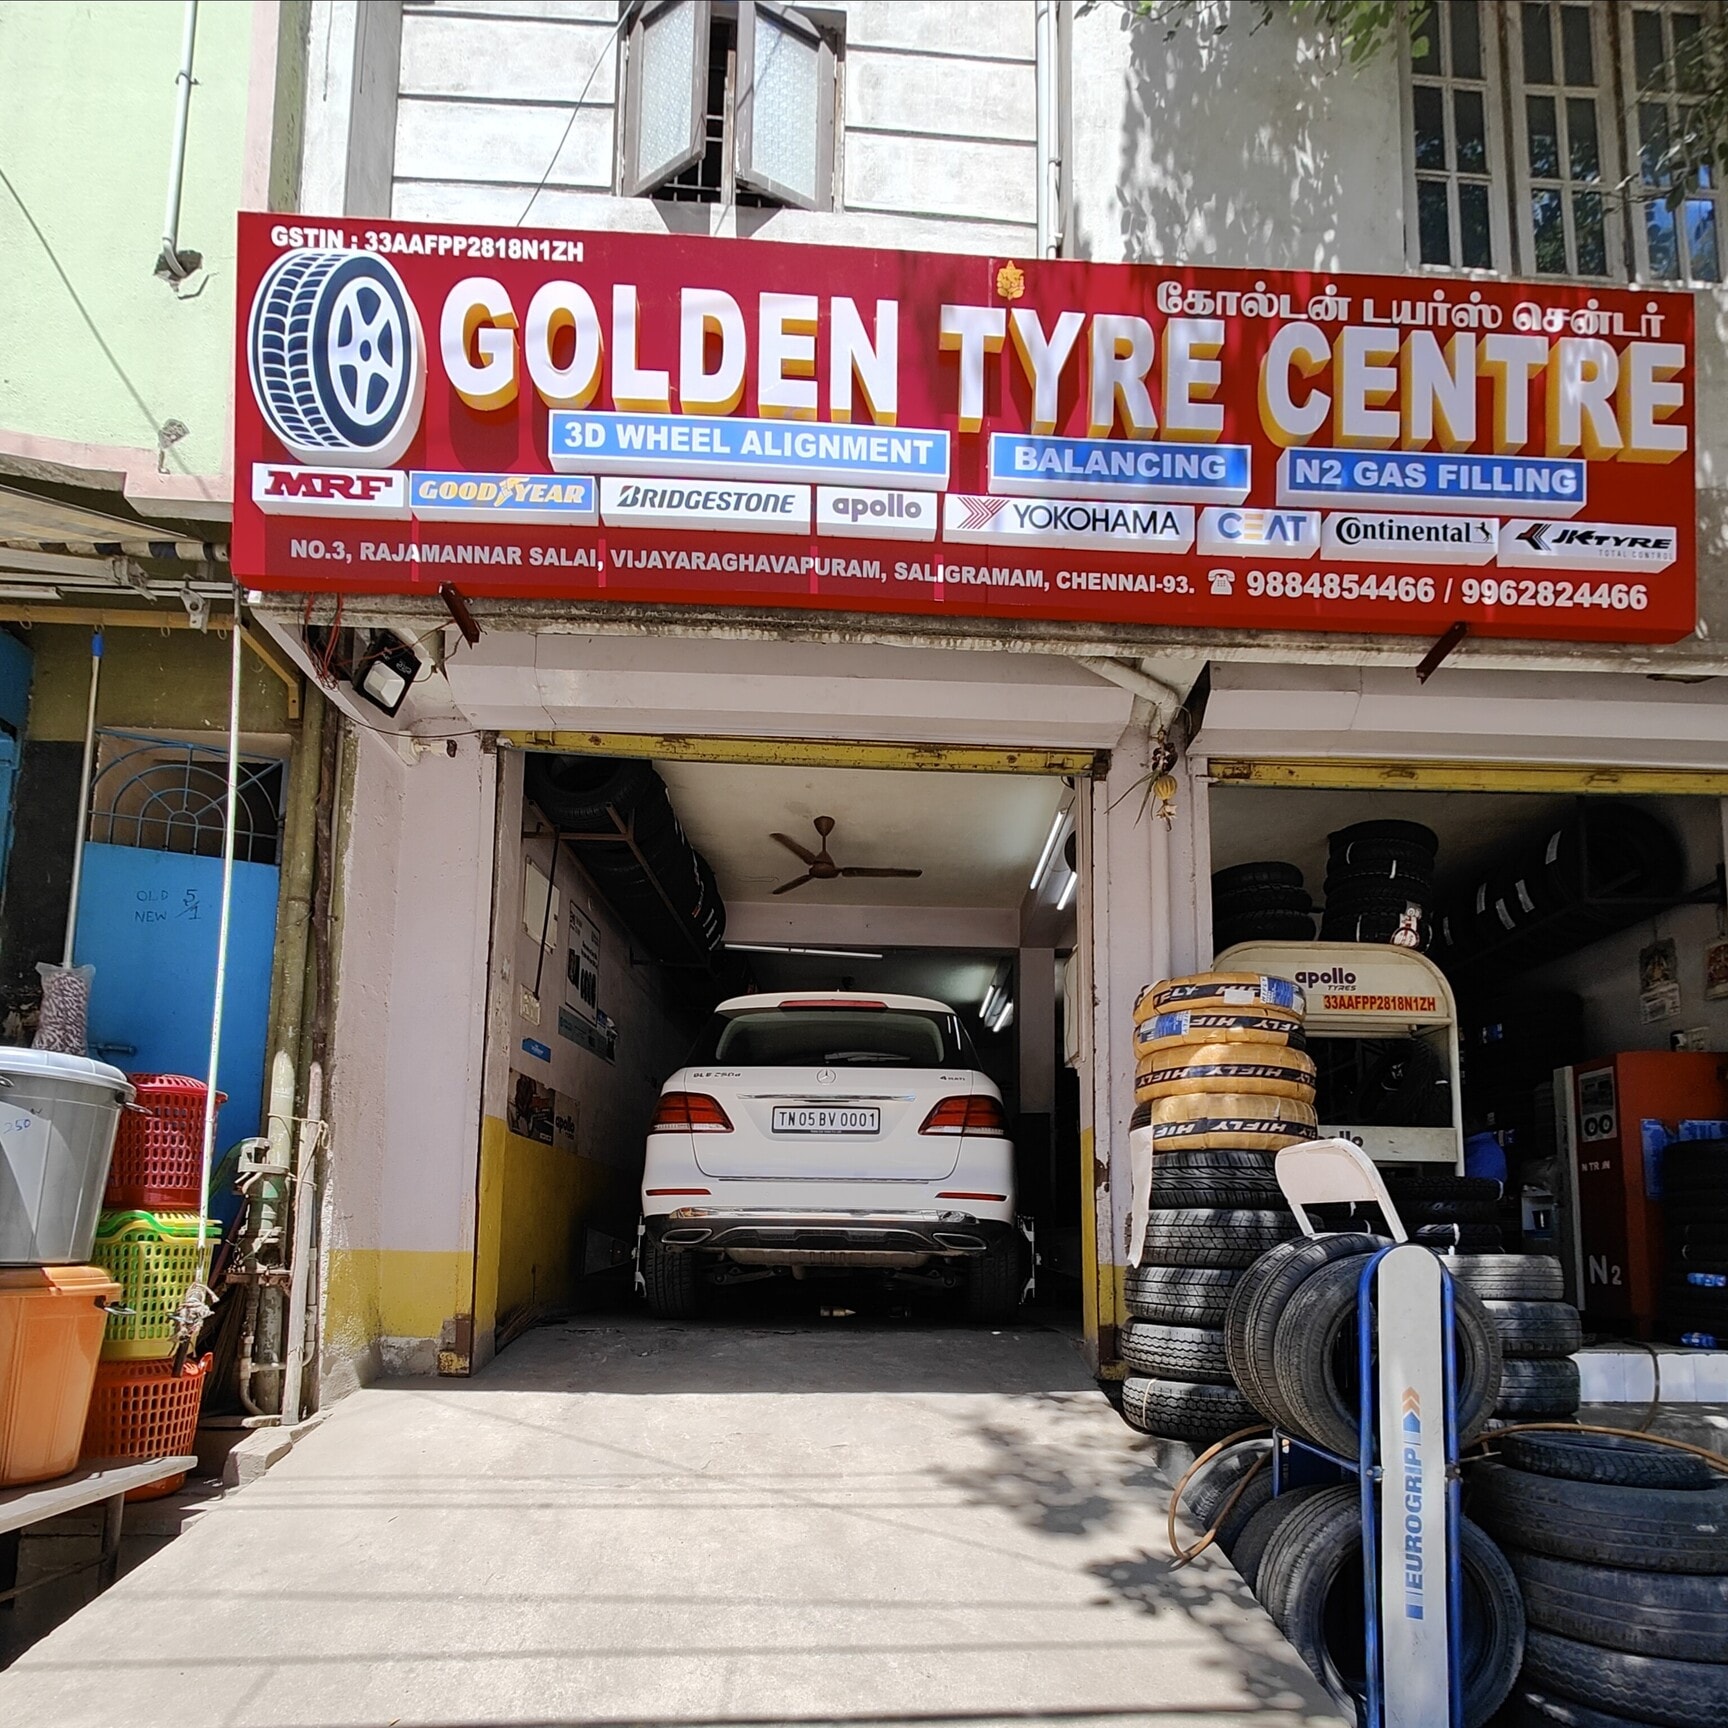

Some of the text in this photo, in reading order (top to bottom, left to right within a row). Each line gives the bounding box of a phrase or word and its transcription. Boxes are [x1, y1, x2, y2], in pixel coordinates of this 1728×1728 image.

[271, 226, 584, 263] GSTIN : 33AAFPP2818N1ZH
[1157, 280, 1665, 338] கோல்டன் டயர்ஸ் சென்டர்
[440, 277, 1688, 457] GOLDEN TYRE CENTRE
[564, 422, 934, 465] 3D WHEEL ALIGNMENT
[1014, 446, 1227, 480] BALANCING
[1296, 459, 1577, 494] N2 GAS FILLING
[264, 470, 393, 500] MRF
[616, 484, 796, 513] BRIDGESTONE
[832, 494, 922, 523] apollo
[1013, 503, 1180, 536] YOKOHAMA
[1217, 511, 1307, 542] CEAT
[1336, 516, 1472, 545] Continental
[1599, 549, 1673, 560] TOTAL CONTROL
[290, 539, 1648, 610] NO.3, RAJAMANNAR SALAI, VIJAYARAGHAVAPURAM, SALIGRAMAM, CHENNAI-93. 9884854466 / 9962824466
[136, 890, 169, 902] OLD
[135, 911, 167, 922] NEW
[1295, 968, 1356, 988] apollo
[1323, 995, 1436, 1011] 33AAFPP2818N1ZH
[1138, 1068, 1190, 1087] HIFLY
[1205, 1066, 1283, 1077] HIFLY
[1154, 1123, 1195, 1138] HIF
[1210, 1121, 1287, 1132] HIFLY
[1589, 1255, 1622, 1285] N2
[1404, 1447, 1423, 1590] EUROGRIP
